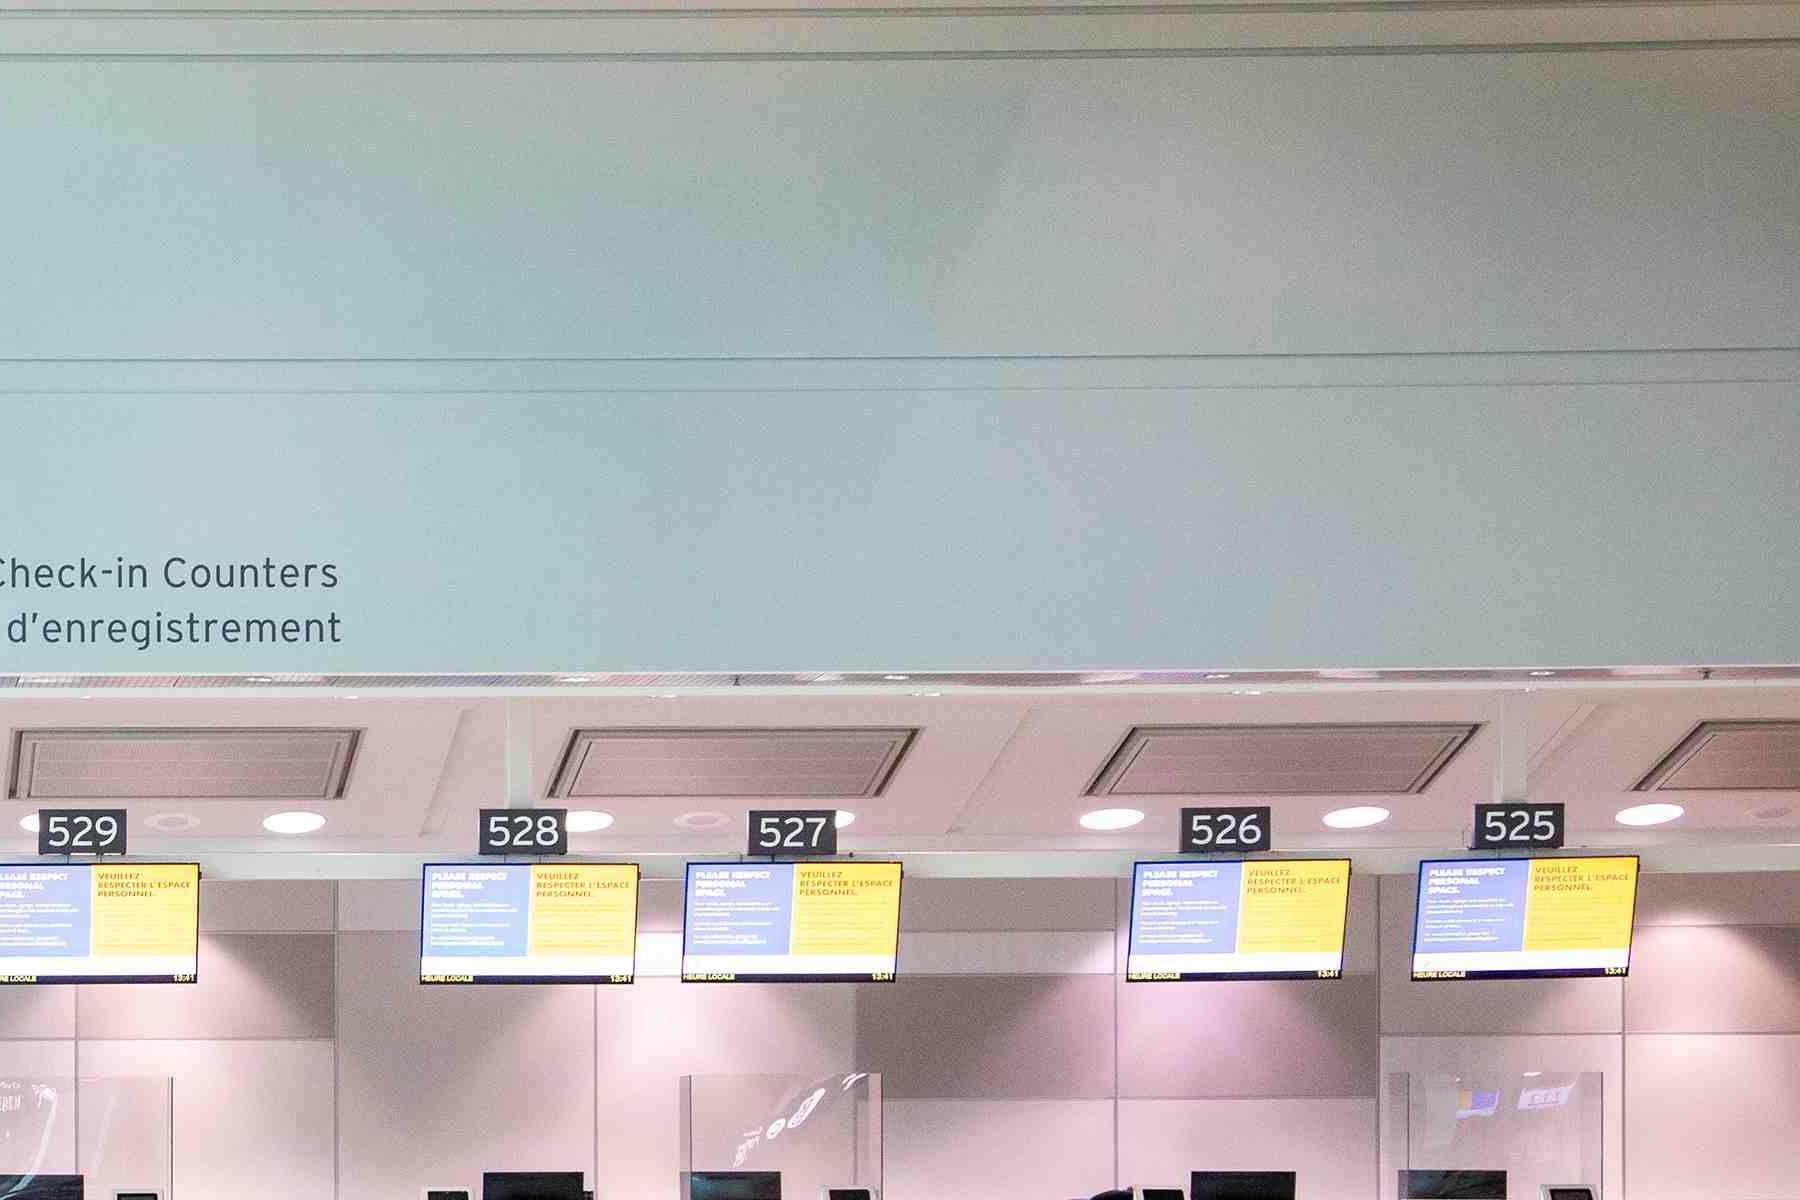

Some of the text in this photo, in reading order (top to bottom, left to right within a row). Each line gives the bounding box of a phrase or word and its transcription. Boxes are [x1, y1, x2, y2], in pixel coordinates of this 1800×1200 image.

[163, 556, 338, 589] Counters
[7, 611, 341, 650] d'enregistrement
[47, 815, 118, 847] 529
[488, 815, 559, 847] 528
[759, 817, 827, 848] 527
[1191, 814, 1262, 845] 526
[1485, 810, 1555, 842] 525
